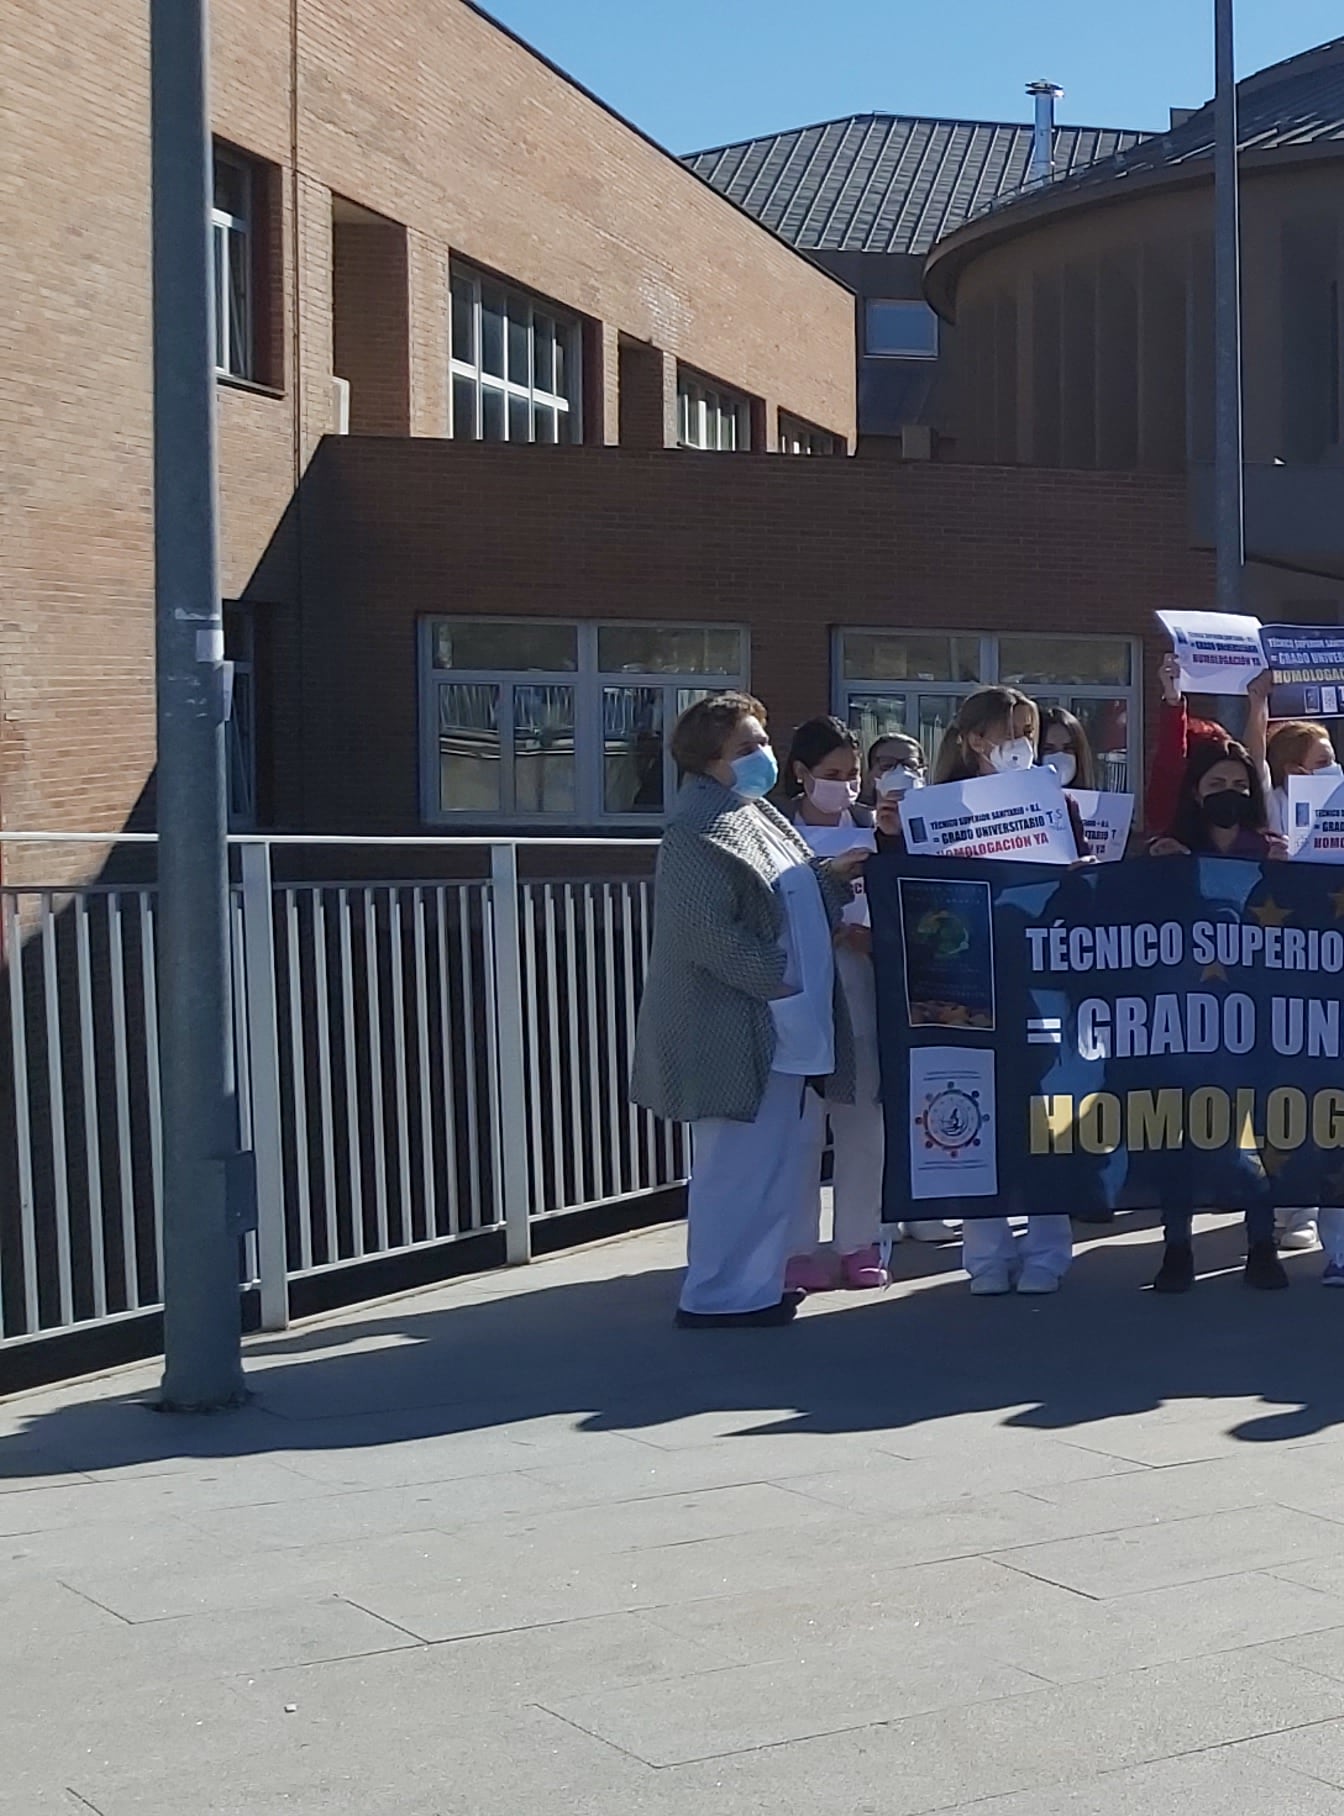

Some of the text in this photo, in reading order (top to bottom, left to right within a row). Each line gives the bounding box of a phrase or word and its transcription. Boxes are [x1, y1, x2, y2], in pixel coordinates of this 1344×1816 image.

[1279, 652, 1310, 664] GRADO
[942, 828, 974, 845] GRADO
[976, 814, 1046, 839] UNIVERSITARIO
[1033, 832, 1049, 846] YA
[1025, 919, 1184, 972] TÉCNICO
[1026, 1017, 1062, 1044] =
[1077, 992, 1256, 1062] GRADO
